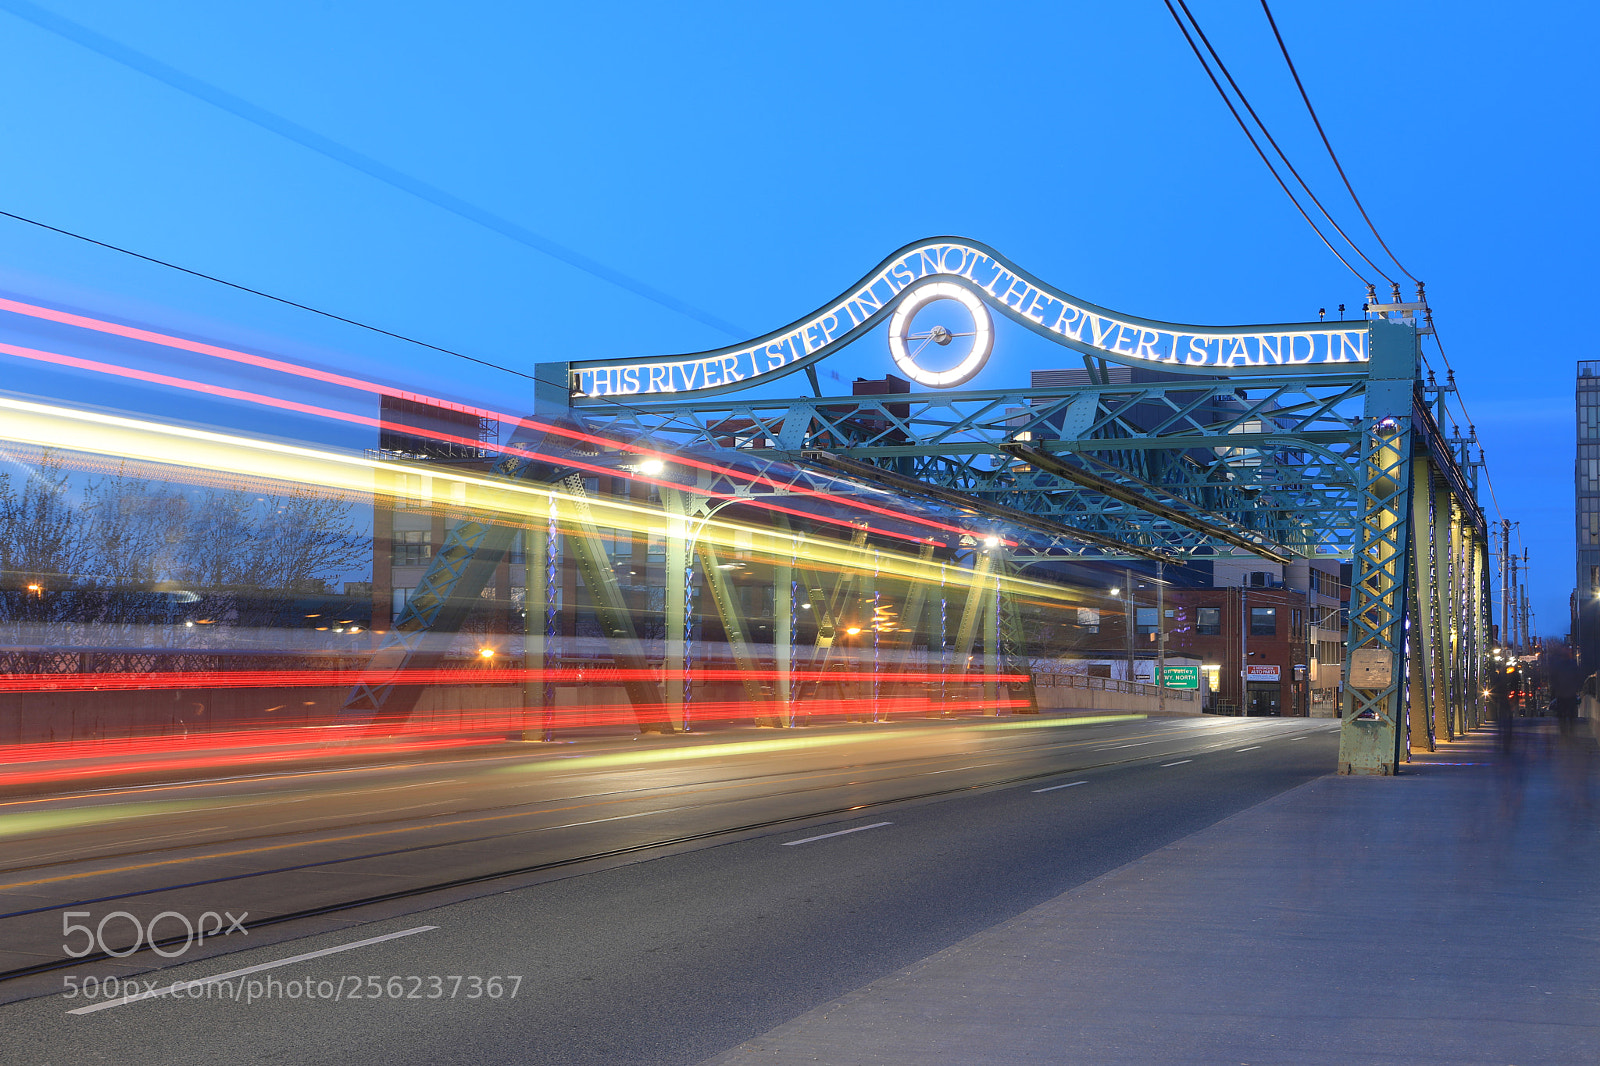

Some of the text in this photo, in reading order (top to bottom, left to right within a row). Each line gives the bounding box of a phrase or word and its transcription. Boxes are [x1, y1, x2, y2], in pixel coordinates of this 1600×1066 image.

[580, 246, 1369, 397] THIS RIVER I STEP IN IS NOT THE RIVER I STAND IN
